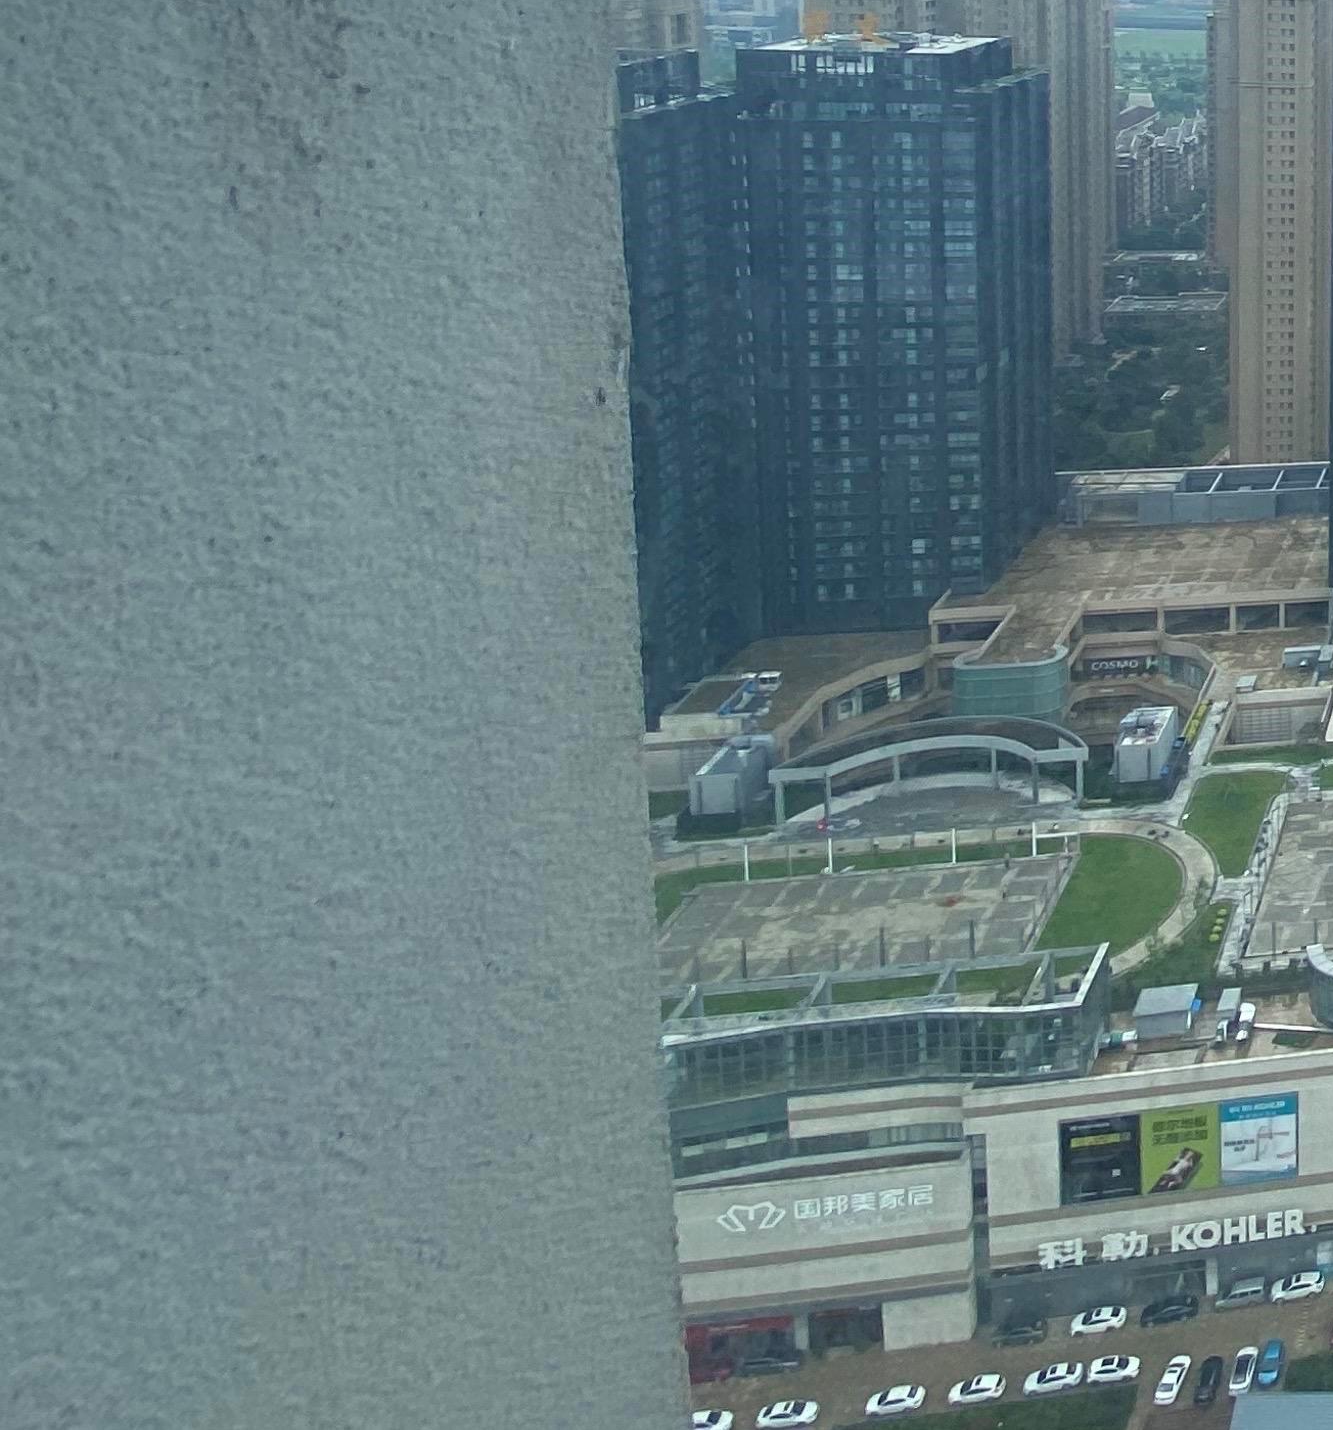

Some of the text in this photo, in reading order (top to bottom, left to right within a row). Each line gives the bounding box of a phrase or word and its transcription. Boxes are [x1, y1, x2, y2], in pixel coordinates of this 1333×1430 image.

[793, 1184, 934, 1220] 国邦美家居
